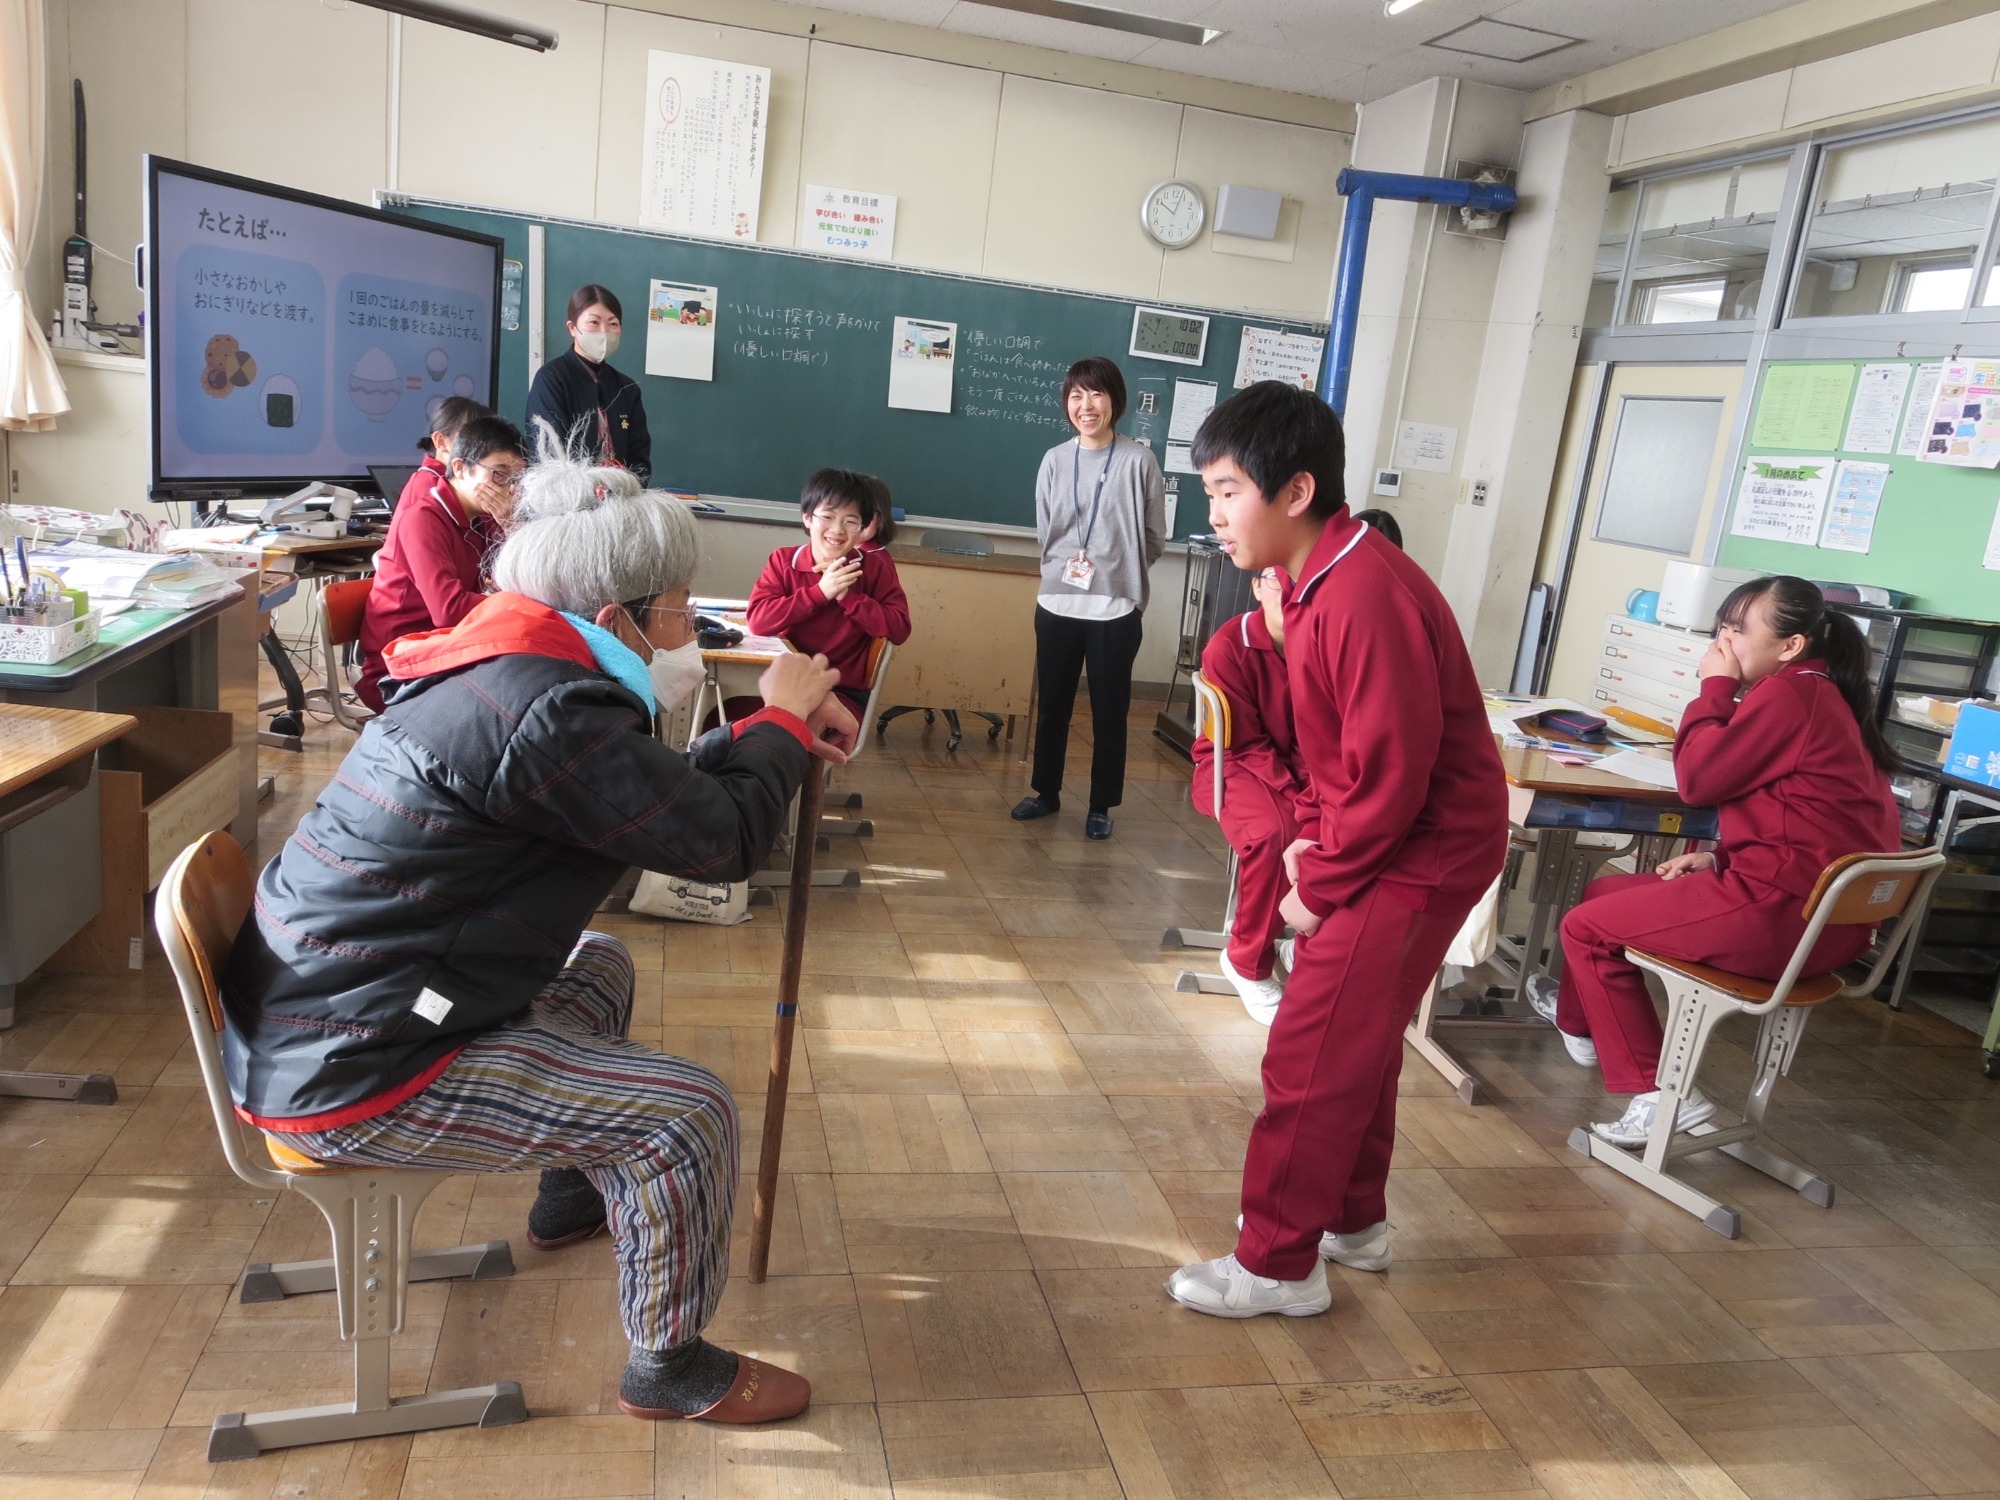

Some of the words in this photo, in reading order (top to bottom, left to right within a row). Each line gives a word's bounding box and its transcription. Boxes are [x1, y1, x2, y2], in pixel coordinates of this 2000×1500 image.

[842, 194, 879, 208] 教育目標
[815, 208, 846, 219] 学び合い
[818, 222, 879, 236] 元気でねばり強い
[826, 236, 869, 249] むつみっ子
[194, 268, 287, 296] 小さなおかしや
[193, 292, 315, 325] おにぎりなどを渡す。
[349, 289, 475, 321] 1回のごはんの量を減らして
[348, 311, 483, 343] こまめに食事をとるようにする。
[738, 324, 816, 341] いっしょに探す
[1139, 392, 1155, 413] 月
[1765, 467, 1806, 481] 1月のめあて
[1162, 475, 1181, 493] 直
